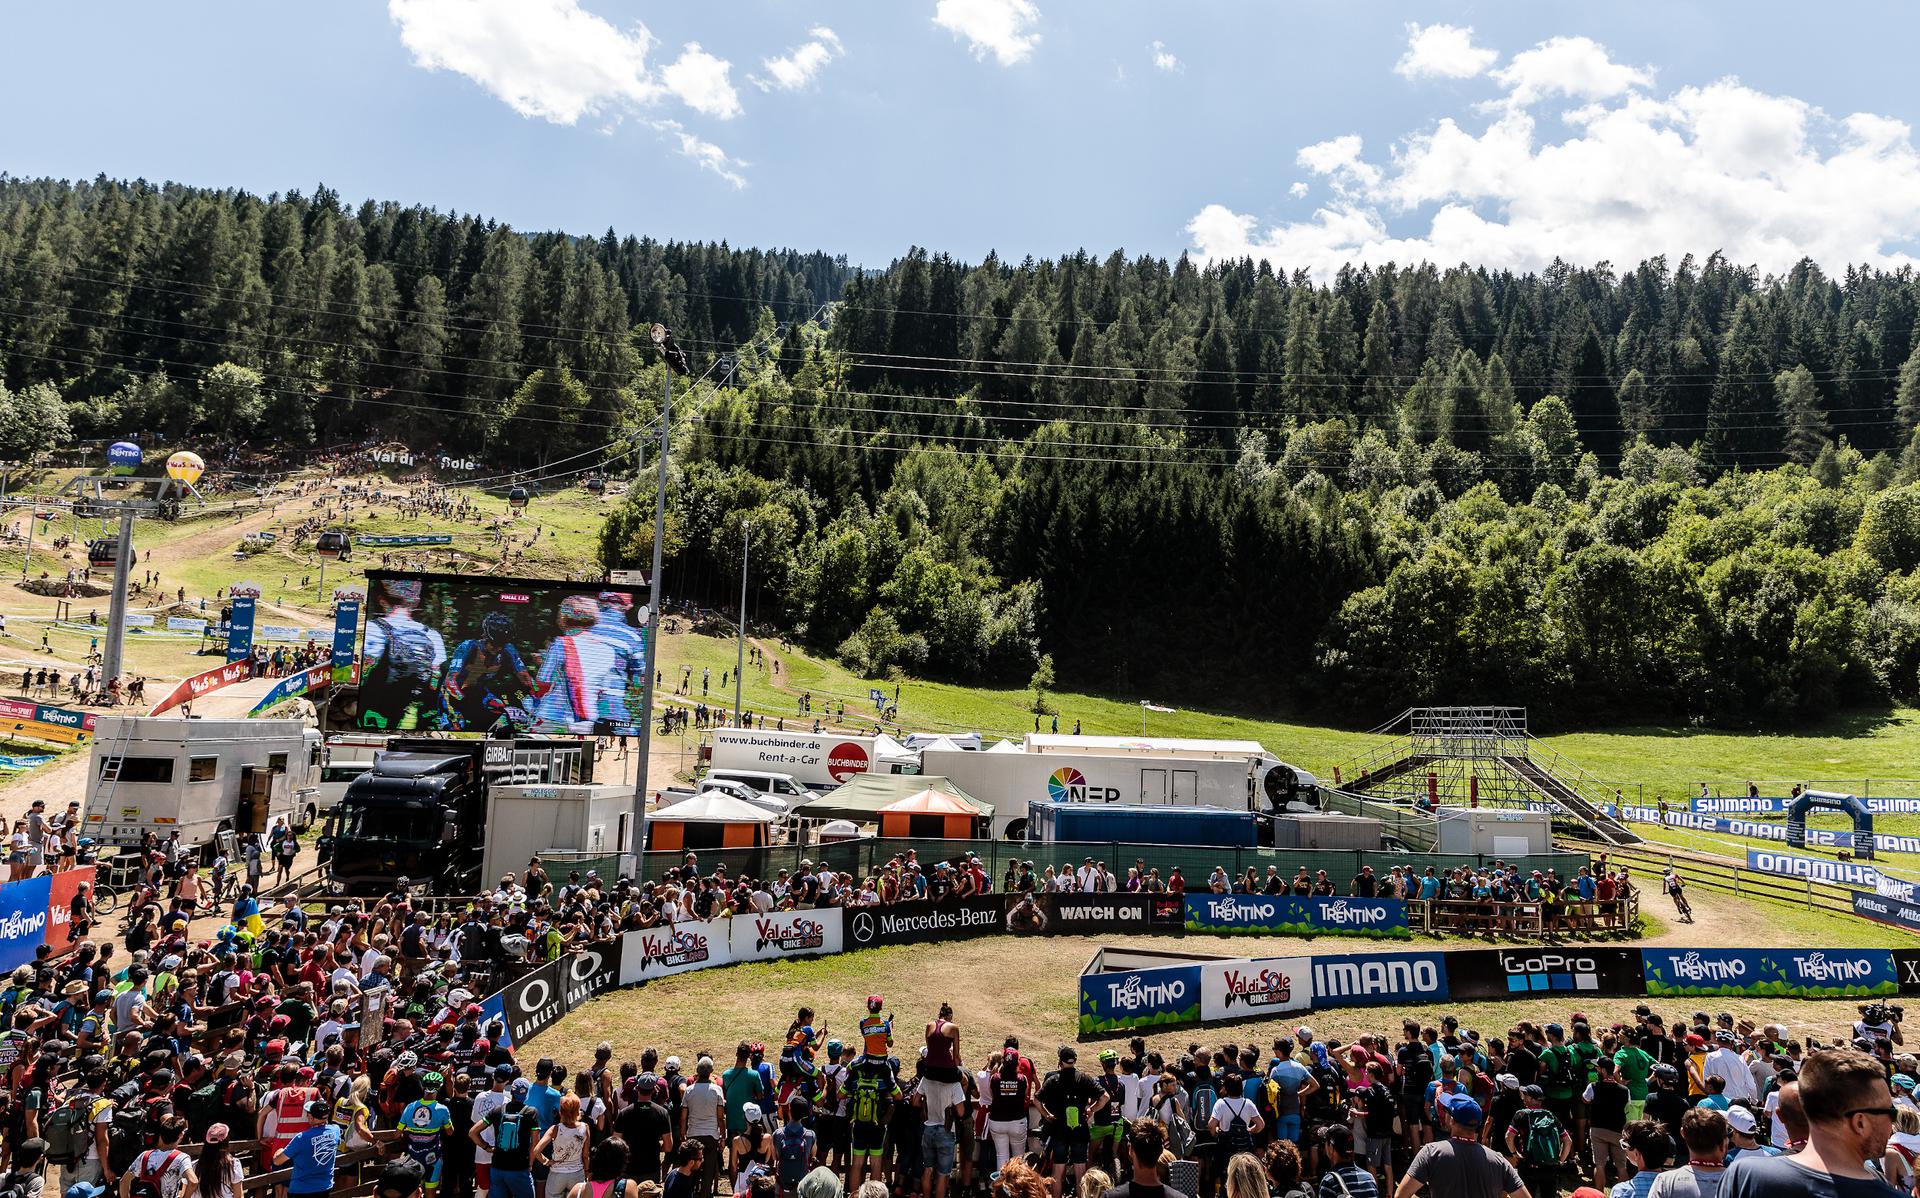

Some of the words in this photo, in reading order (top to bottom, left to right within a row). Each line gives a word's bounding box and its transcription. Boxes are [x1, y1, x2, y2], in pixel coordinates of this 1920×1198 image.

[372, 450, 395, 463] Val
[400, 453, 414, 466] di
[18, 707, 33, 716] SPORT
[42, 709, 78, 724] TRENTINO
[718, 733, 821, 750] www.buchbinder.de
[758, 751, 820, 766] Rent-a-Car
[827, 758, 869, 768] BUCHBINDER
[1070, 787, 1121, 803] NEP
[1809, 796, 1841, 805] SHIMANO
[1696, 798, 1773, 812] SHIMANO
[1867, 799, 1920, 813] SHIMA
[1059, 906, 1115, 921] WATCH
[1118, 906, 1143, 920] ON
[1208, 900, 1275, 922] TRENTINO
[1319, 902, 1387, 925] TRENTINO
[1855, 898, 1888, 914] Mitas
[880, 908, 998, 935] Mercedes-Benz
[1896, 907, 1920, 923] Mita
[1504, 954, 1596, 973] GoPro
[1668, 955, 1746, 981] TRENTINO
[1793, 956, 1872, 981] TRENTINO
[1313, 960, 1439, 997] IMANO
[567, 970, 614, 1005] OAKLEY
[1107, 978, 1185, 1010] TRENTINO
[515, 1001, 560, 1040] OAKLEY
